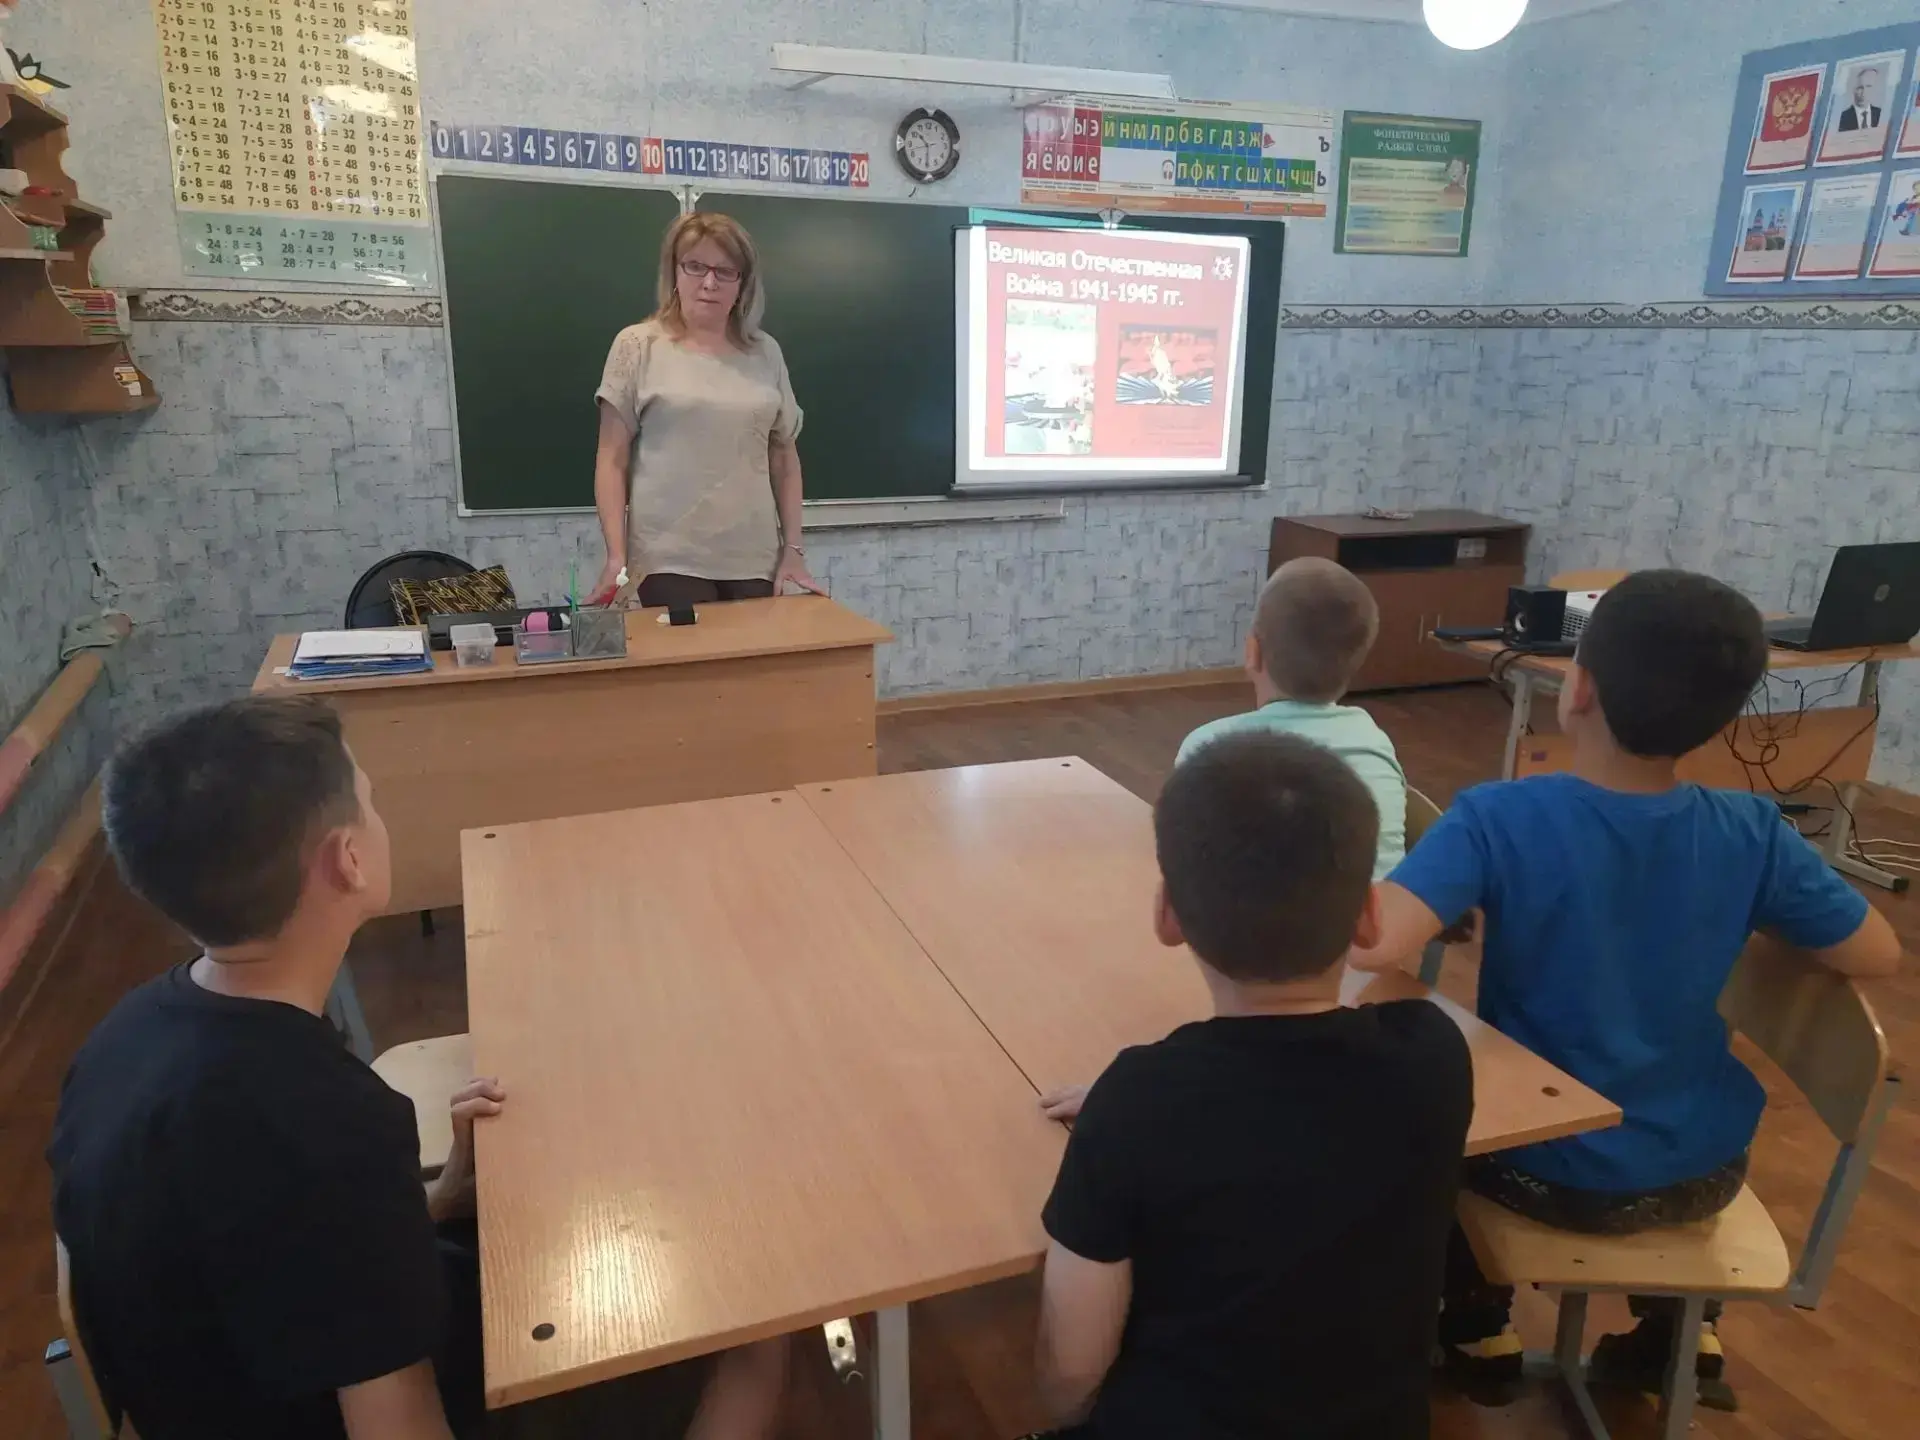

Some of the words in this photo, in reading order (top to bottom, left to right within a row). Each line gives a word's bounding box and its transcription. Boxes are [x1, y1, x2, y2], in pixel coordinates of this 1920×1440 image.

[269, 9, 281, 20] 15
[203, 18, 215, 30] 12
[270, 25, 283, 36] 18
[205, 34, 217, 46] 14
[271, 40, 283, 52] 21
[206, 50, 218, 61] 16
[336, 49, 349, 60] 28
[273, 56, 286, 67] 24
[208, 66, 220, 77] 18
[337, 64, 350, 75] 32
[274, 72, 286, 83] 27
[210, 86, 223, 97] 12
[277, 92, 289, 103] 14
[212, 102, 225, 113] 18
[277, 108, 290, 119] 21
[279, 123, 292, 134] 28
[403, 120, 415, 130] 27
[281, 138, 293, 149] 35
[404, 134, 416, 145] 36
[282, 154, 295, 164] 42
[405, 149, 417, 160] 45
[436, 128, 449, 153] 0
[459, 129, 469, 155] 1
[480, 131, 493, 157] 2
[503, 132, 514, 158] 3
[523, 134, 536, 160] 4
[544, 136, 556, 161] 5
[564, 137, 576, 162] 6
[584, 139, 596, 164] 7
[605, 141, 617, 165] 8
[625, 142, 638, 167] 9
[644, 144, 660, 168] 10
[666, 145, 683, 170] 11
[688, 147, 706, 172] 12
[710, 148, 727, 173] 13
[730, 150, 749, 175] 14
[752, 151, 769, 176] 15
[772, 153, 790, 178] 16
[793, 154, 810, 179] 17
[813, 156, 830, 180] 18
[833, 157, 849, 181] 19
[851, 159, 868, 183] 20
[284, 169, 296, 179] 49
[346, 174, 359, 184] 56
[220, 180, 232, 190] 48
[285, 184, 298, 194] 56
[221, 194, 234, 205] 54
[286, 199, 299, 210] 63
[349, 204, 362, 214] 72
[989, 241, 1066, 269] Великая
[1072, 249, 1203, 281] Отечественная
[1006, 272, 1064, 297] Война
[1070, 279, 1158, 305] 1941-1945
[1163, 290, 1184, 306] гг.
